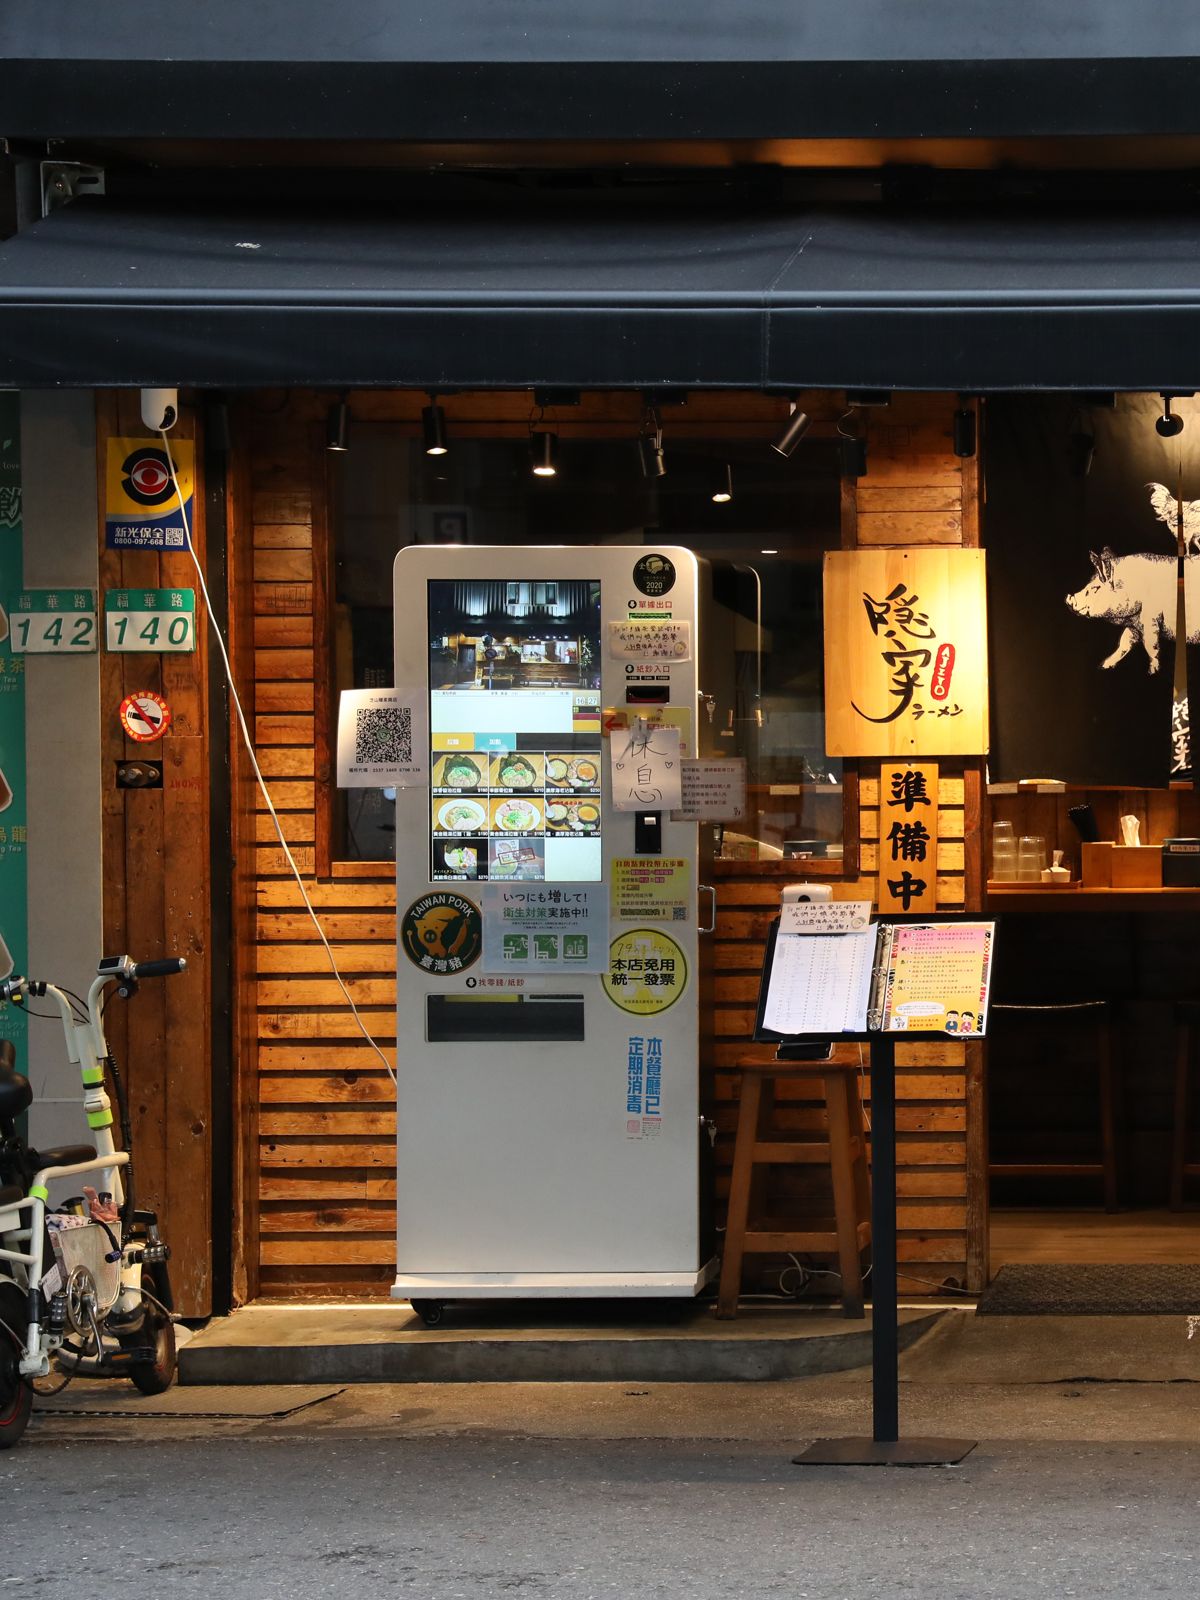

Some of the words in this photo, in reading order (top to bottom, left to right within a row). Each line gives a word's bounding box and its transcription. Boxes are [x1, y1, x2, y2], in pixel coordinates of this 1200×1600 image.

[115, 527, 164, 538] 新光保全
[114, 538, 164, 546] 0800-097-668
[19, 594, 86, 609] 福華路
[117, 593, 183, 608] 福華路
[639, 601, 673, 609] 單據出口
[18, 617, 93, 646] 142
[114, 616, 189, 645] 140
[636, 665, 670, 673] 紙鈔入口
[911, 703, 963, 720] ラーメン
[628, 737, 669, 804] 休息
[886, 772, 931, 911] 準備中
[503, 890, 587, 903] いつにも増して!
[411, 895, 446, 918] TAIWAN
[448, 896, 475, 917] PORK
[503, 907, 589, 918] 衛生対策実施中!!
[420, 954, 463, 972] 臺灣豬
[611, 959, 675, 971] 本店免用
[611, 973, 675, 986] 統一發票
[627, 1037, 644, 1114] 定期消毒
[645, 1037, 662, 1114] 本餐廳已
